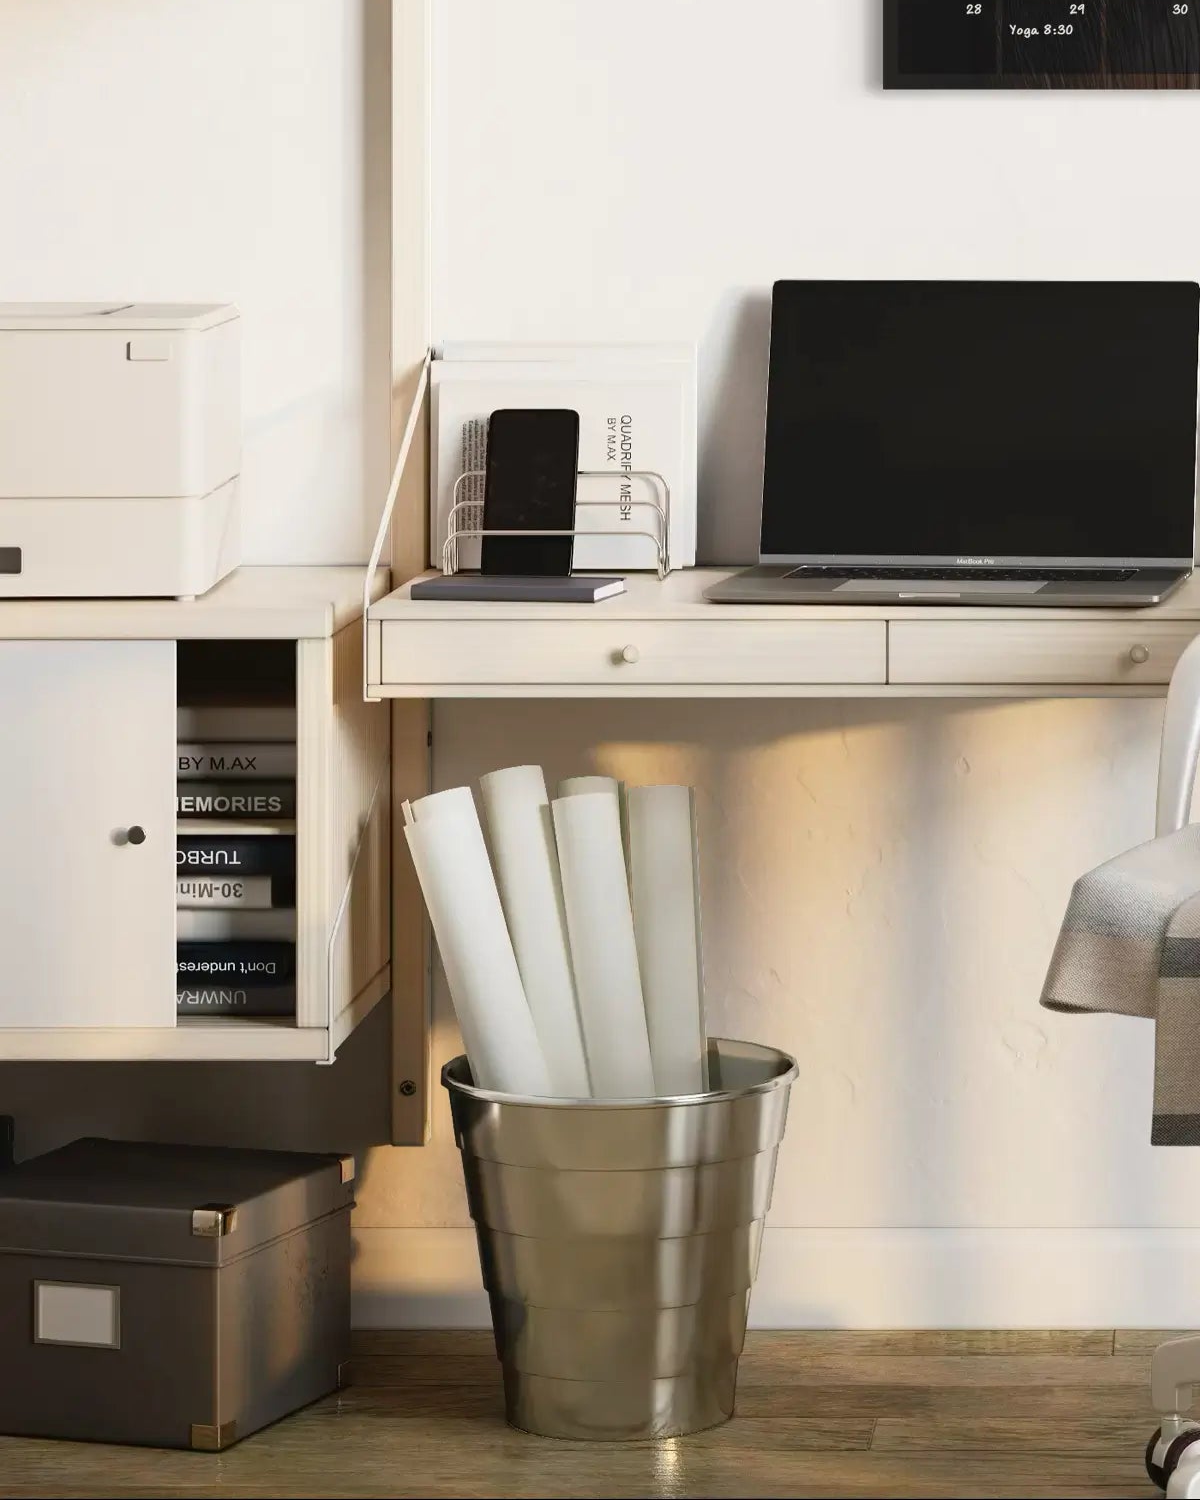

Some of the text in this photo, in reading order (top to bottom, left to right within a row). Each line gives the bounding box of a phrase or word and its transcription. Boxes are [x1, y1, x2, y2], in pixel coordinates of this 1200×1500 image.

[966, 4, 982, 15] 28
[1070, 4, 1085, 15] 29
[1172, 4, 1188, 15] 30
[1009, 24, 1073, 38] Yoga 8:30
[607, 418, 616, 460] BY M.AX
[620, 485, 631, 521] MESH
[178, 756, 257, 771] BY M.AX
[176, 796, 282, 812] EMORIES
[239, 961, 276, 974] Don't
